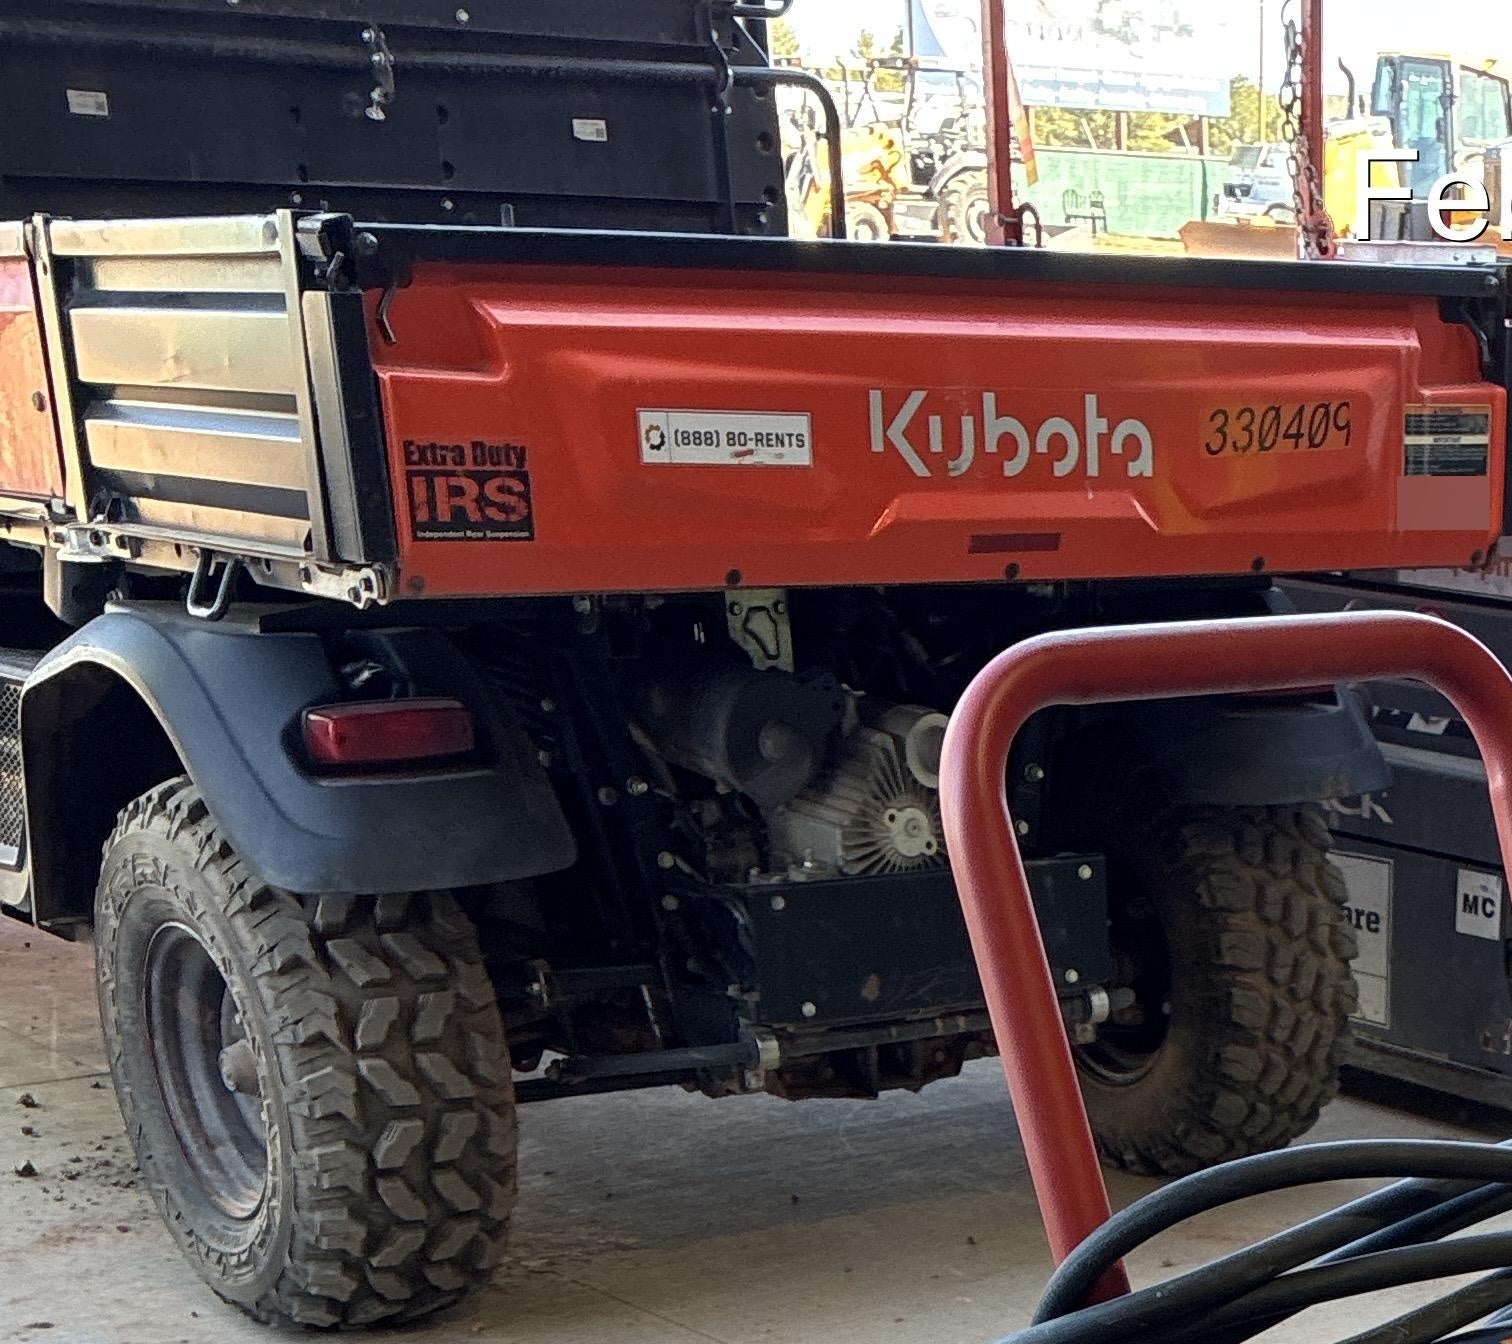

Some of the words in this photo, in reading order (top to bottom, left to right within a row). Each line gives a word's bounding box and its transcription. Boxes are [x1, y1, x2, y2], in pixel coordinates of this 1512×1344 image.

[674, 429, 720, 447] (888)
[726, 431, 805, 448] 80-RENTS
[868, 389, 1154, 477] Kubota
[1205, 401, 1352, 456] 330409
[403, 441, 466, 467] Extra
[470, 441, 527, 469] Duty
[411, 476, 529, 522] IRS
[1341, 905, 1381, 934] are
[1461, 893, 1497, 919] MC
